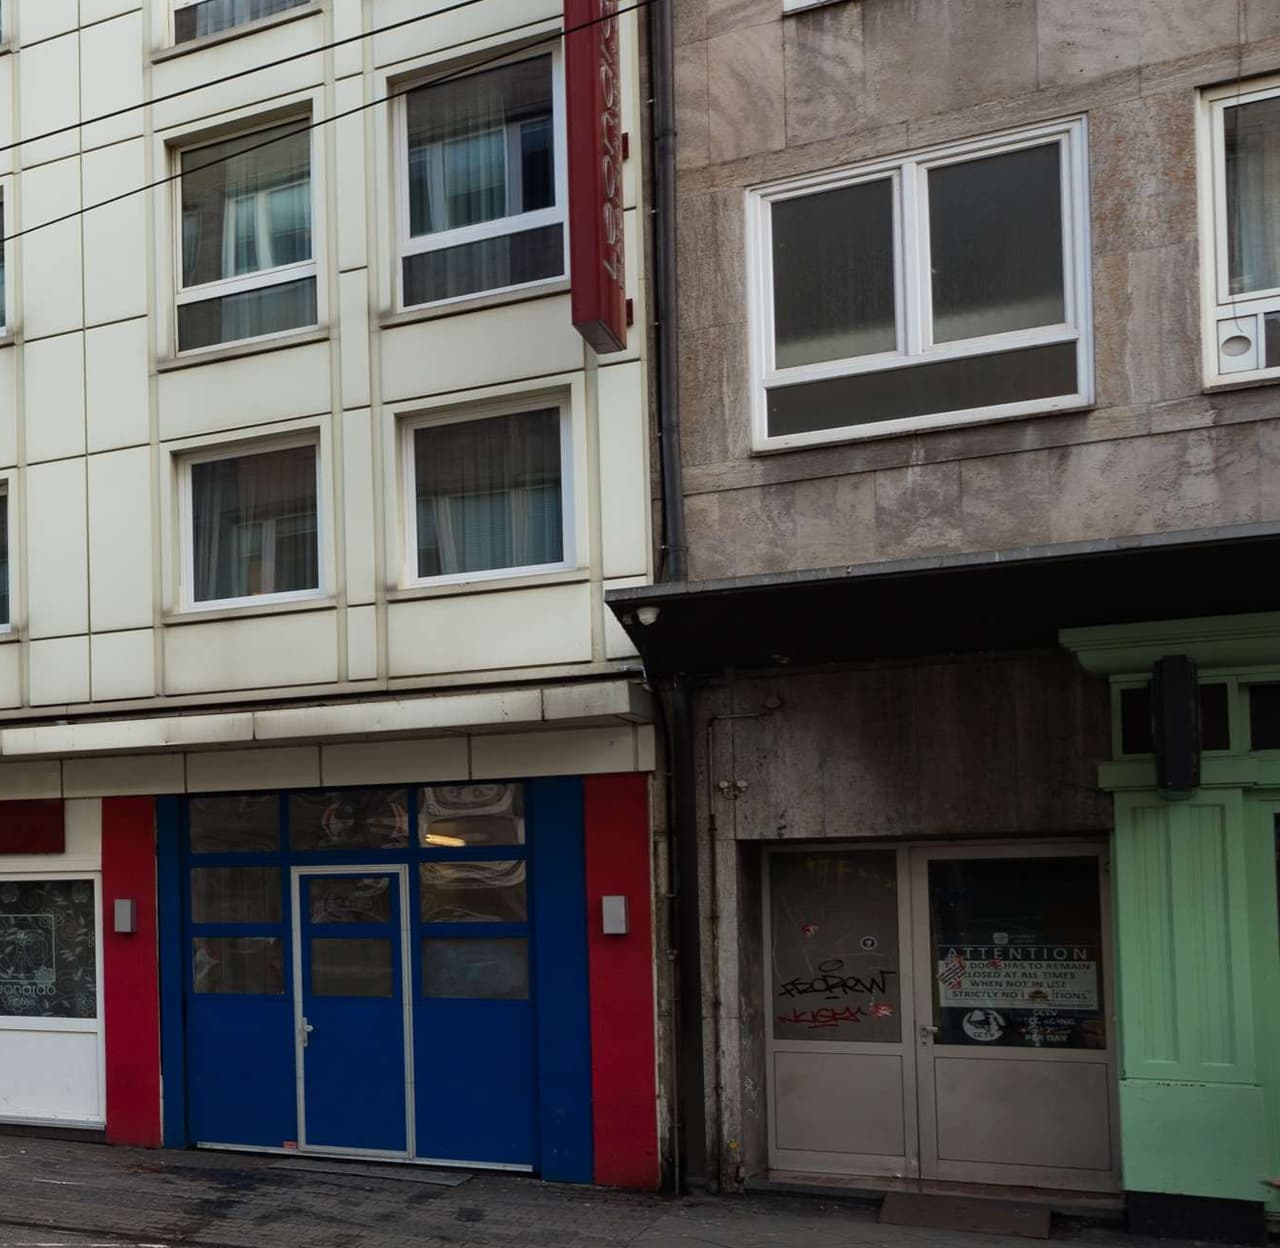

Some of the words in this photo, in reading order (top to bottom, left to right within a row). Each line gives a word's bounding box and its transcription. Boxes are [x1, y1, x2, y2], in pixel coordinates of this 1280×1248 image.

[946, 946, 1088, 961] ATTENTION
[1042, 971, 1076, 979] TIMES
[970, 980, 1003, 988] WHEN
[1006, 980, 1027, 988] NOT
[1032, 980, 1043, 988] IN
[1046, 980, 1067, 988] USE
[951, 991, 998, 999] STRICTLY
[1001, 991, 1018, 999] NO
